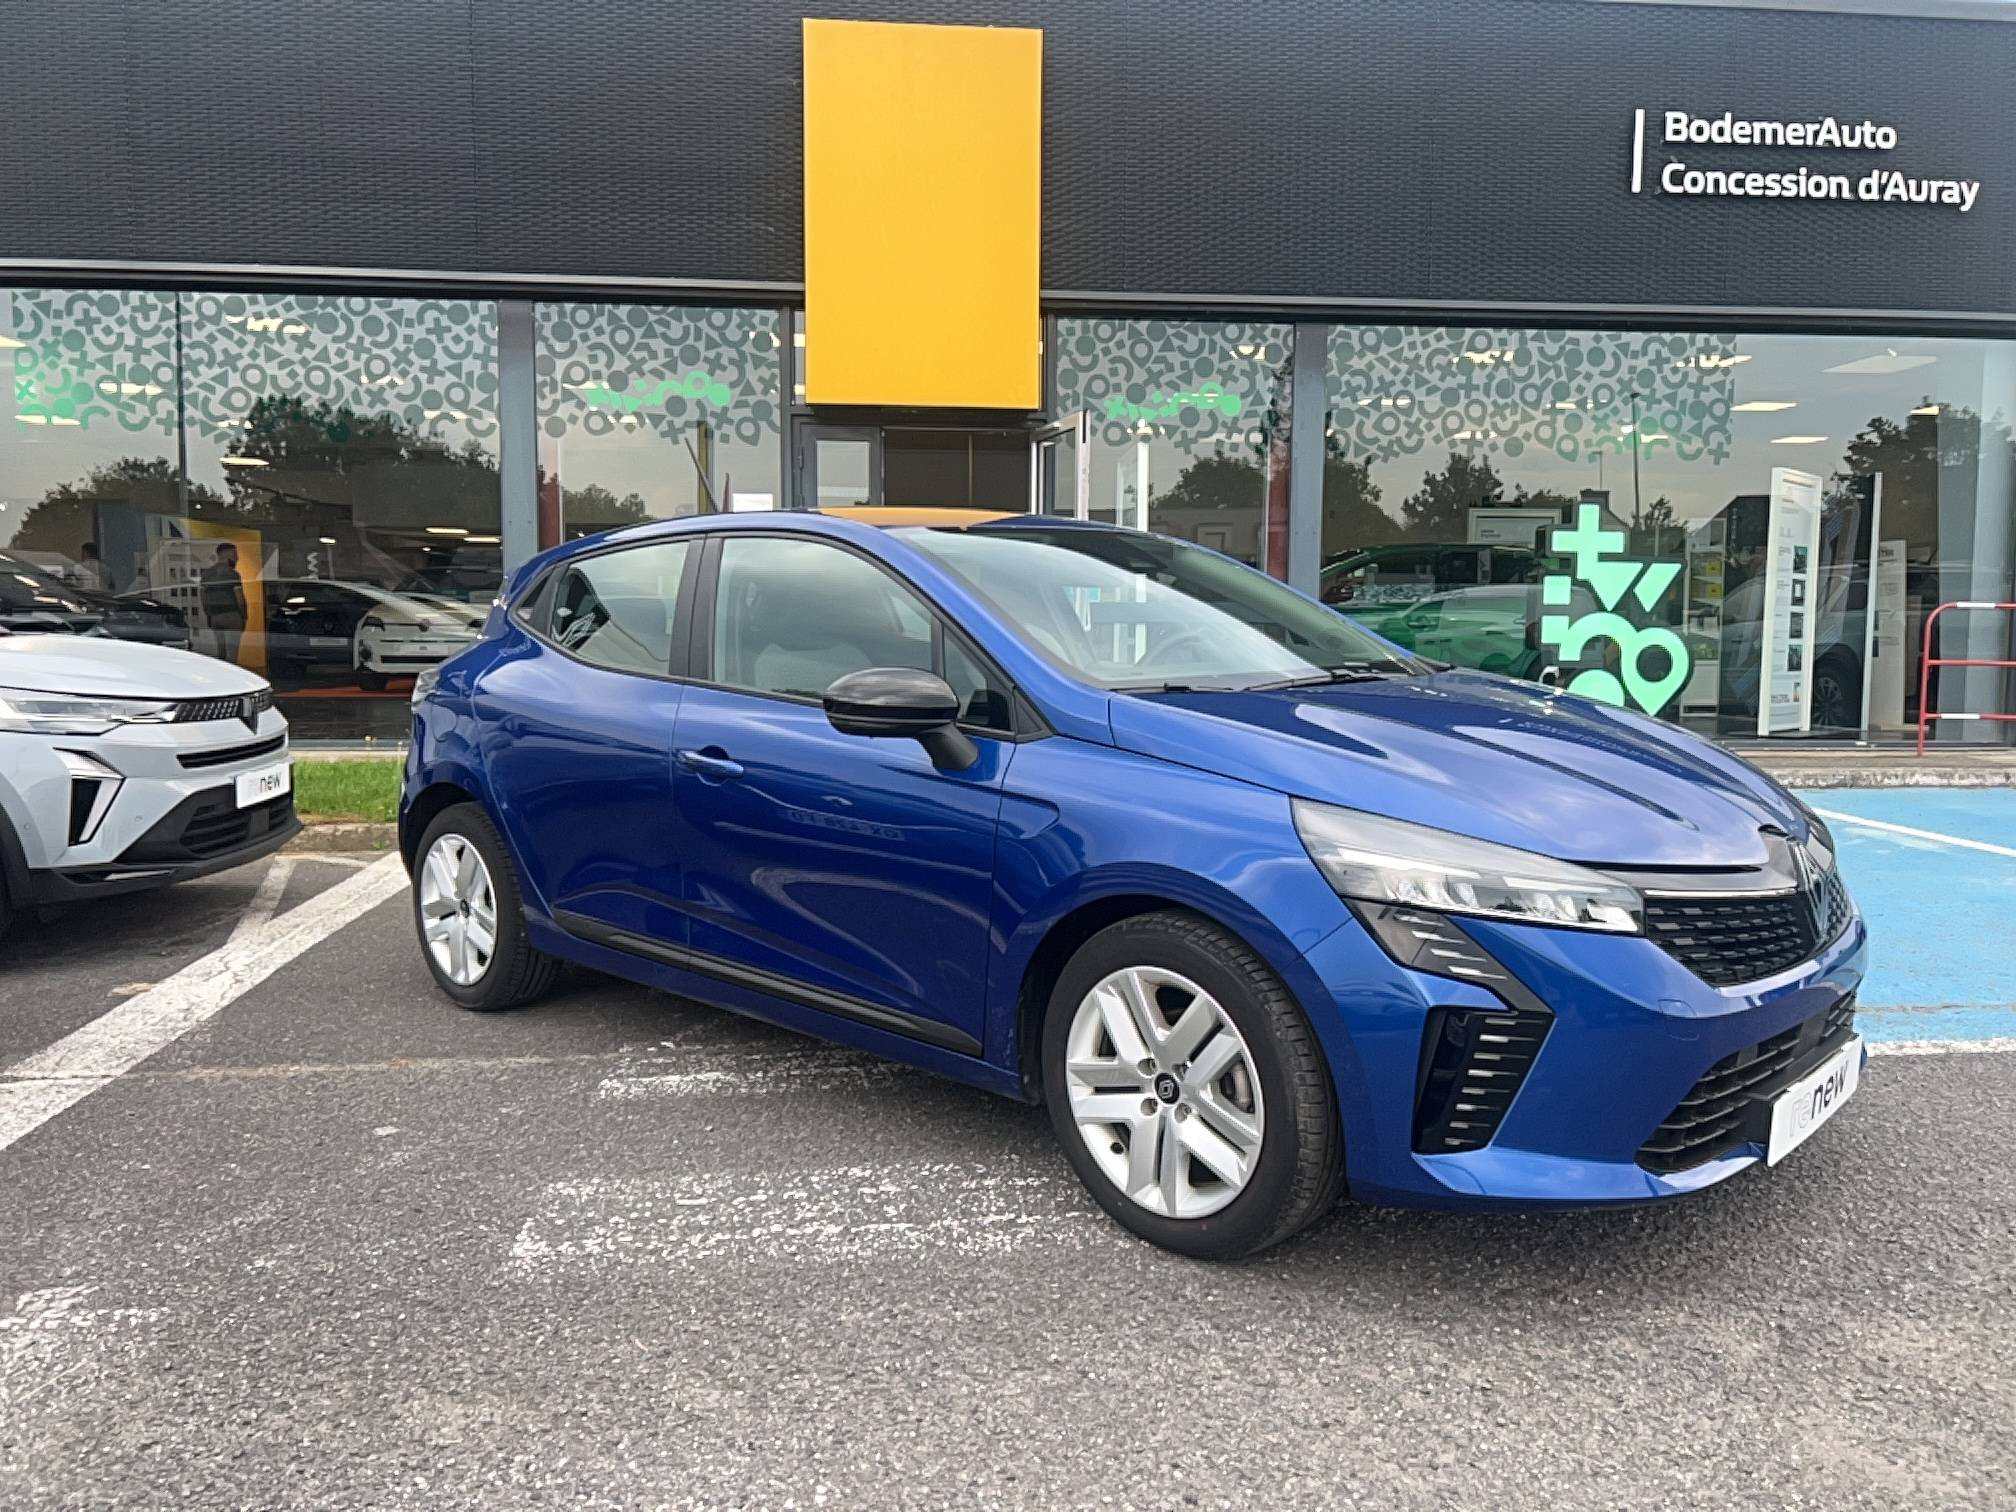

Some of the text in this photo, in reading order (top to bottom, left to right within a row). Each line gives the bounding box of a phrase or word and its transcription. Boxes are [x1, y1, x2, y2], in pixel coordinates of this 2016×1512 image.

[1664, 110, 1897, 150] BodemerAuto
[1661, 162, 1980, 212] Concession d'Auray
